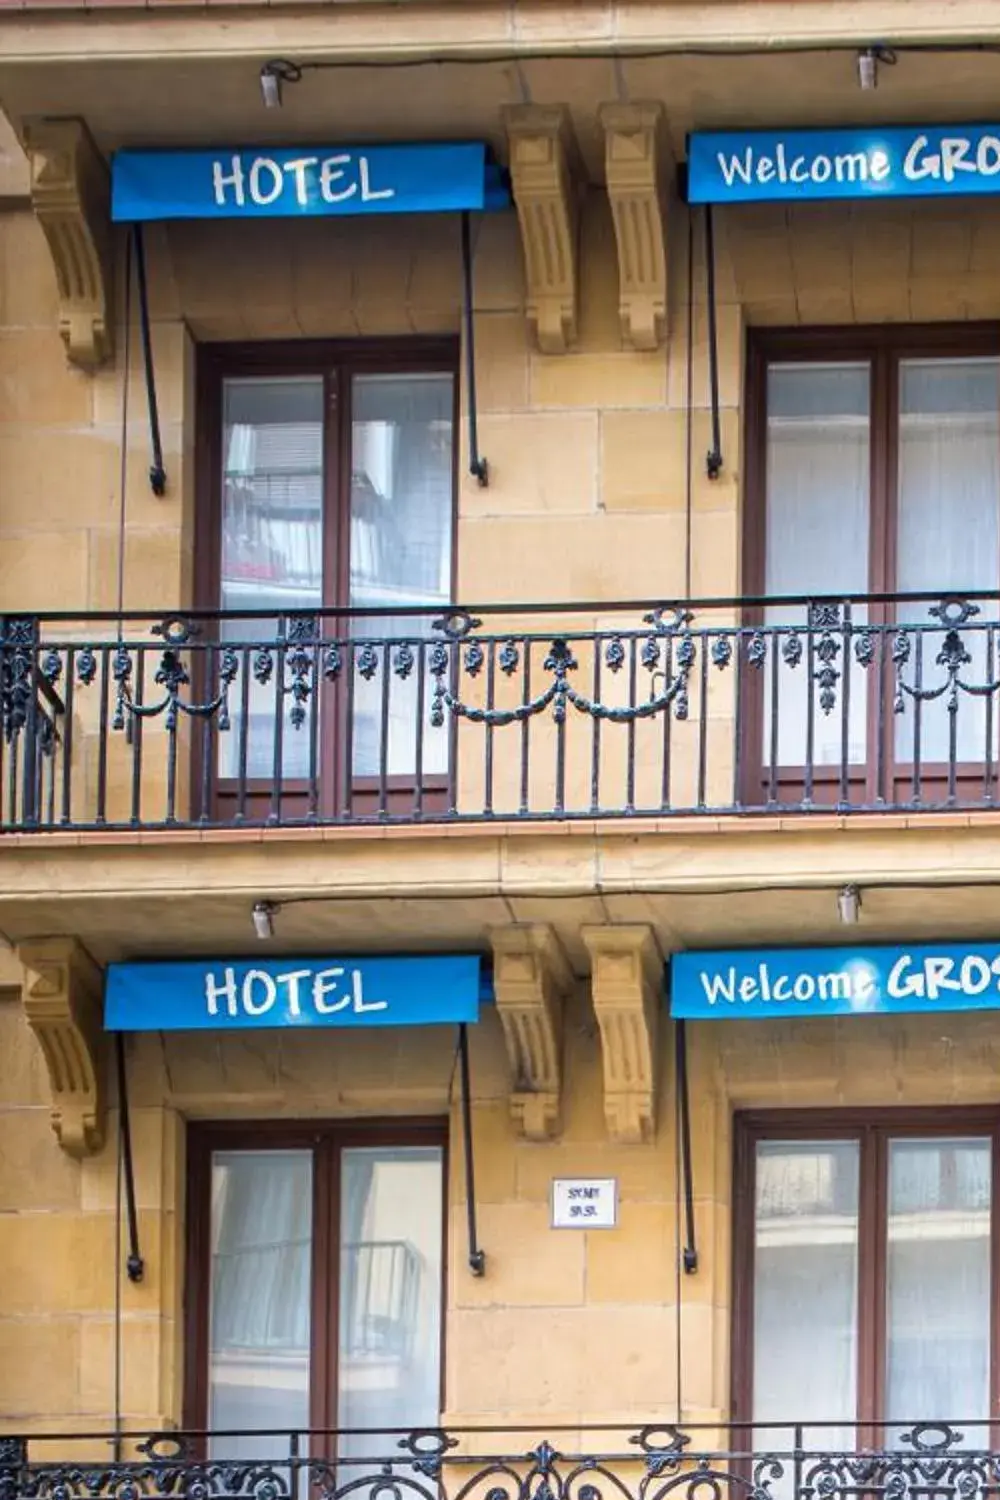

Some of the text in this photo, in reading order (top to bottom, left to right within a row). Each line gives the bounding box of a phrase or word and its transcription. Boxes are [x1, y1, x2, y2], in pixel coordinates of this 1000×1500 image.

[213, 155, 395, 206] HOTEL
[717, 144, 890, 187] Welcome
[205, 967, 387, 1017] HOTEL
[699, 967, 875, 1004] Welcome
